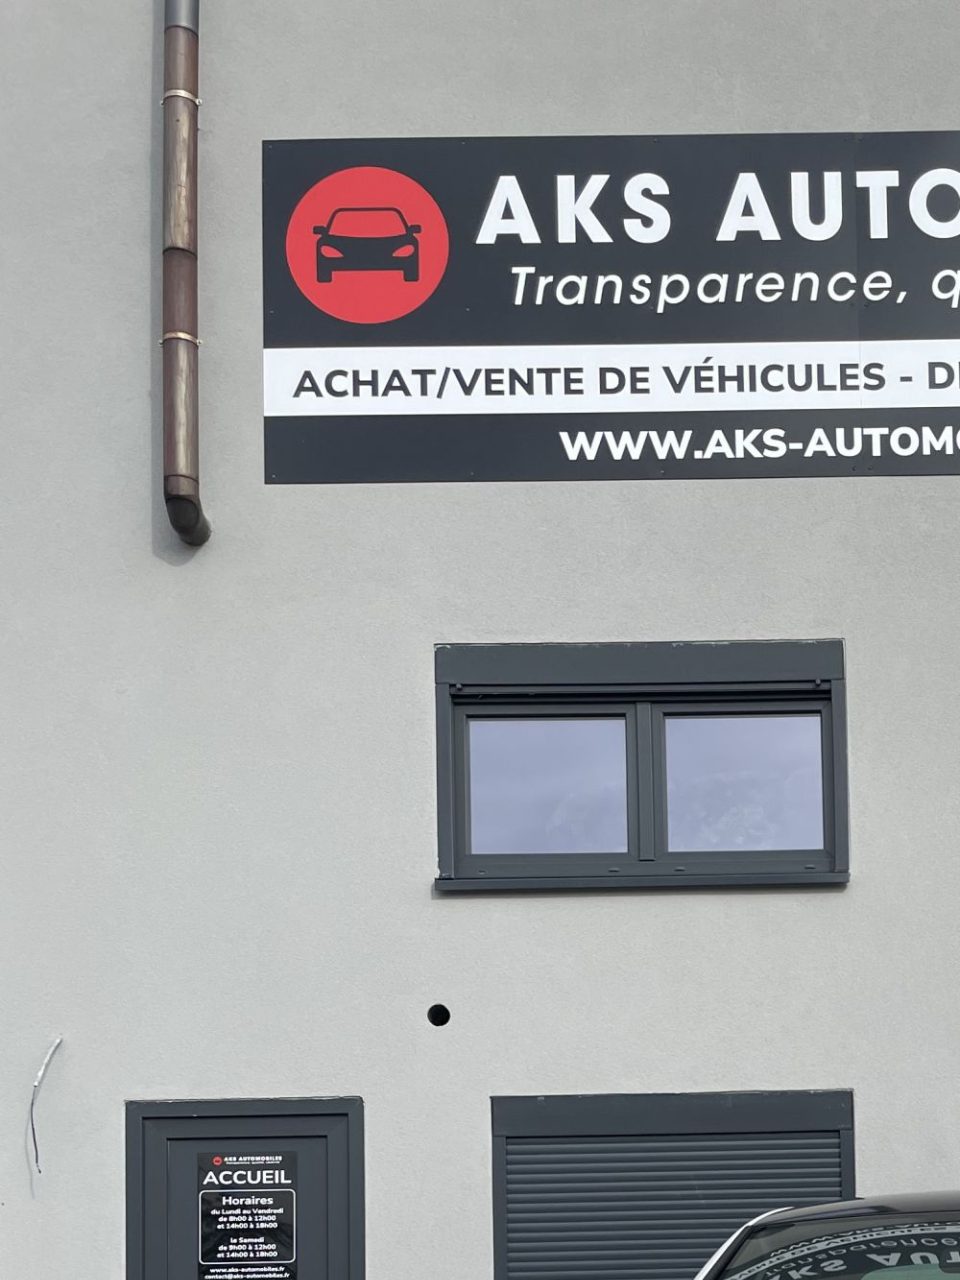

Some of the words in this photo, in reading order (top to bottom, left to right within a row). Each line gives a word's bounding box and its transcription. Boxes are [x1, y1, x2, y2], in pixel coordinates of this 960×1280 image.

[475, 172, 671, 245] AKS
[510, 266, 907, 314] Transparence,
[292, 366, 585, 399] ACHAT/VENTE
[600, 366, 650, 394] DE
[662, 357, 886, 393] VÉHICULES
[202, 1170, 292, 1185] ACCUEIL
[222, 1196, 274, 1206] Horaires
